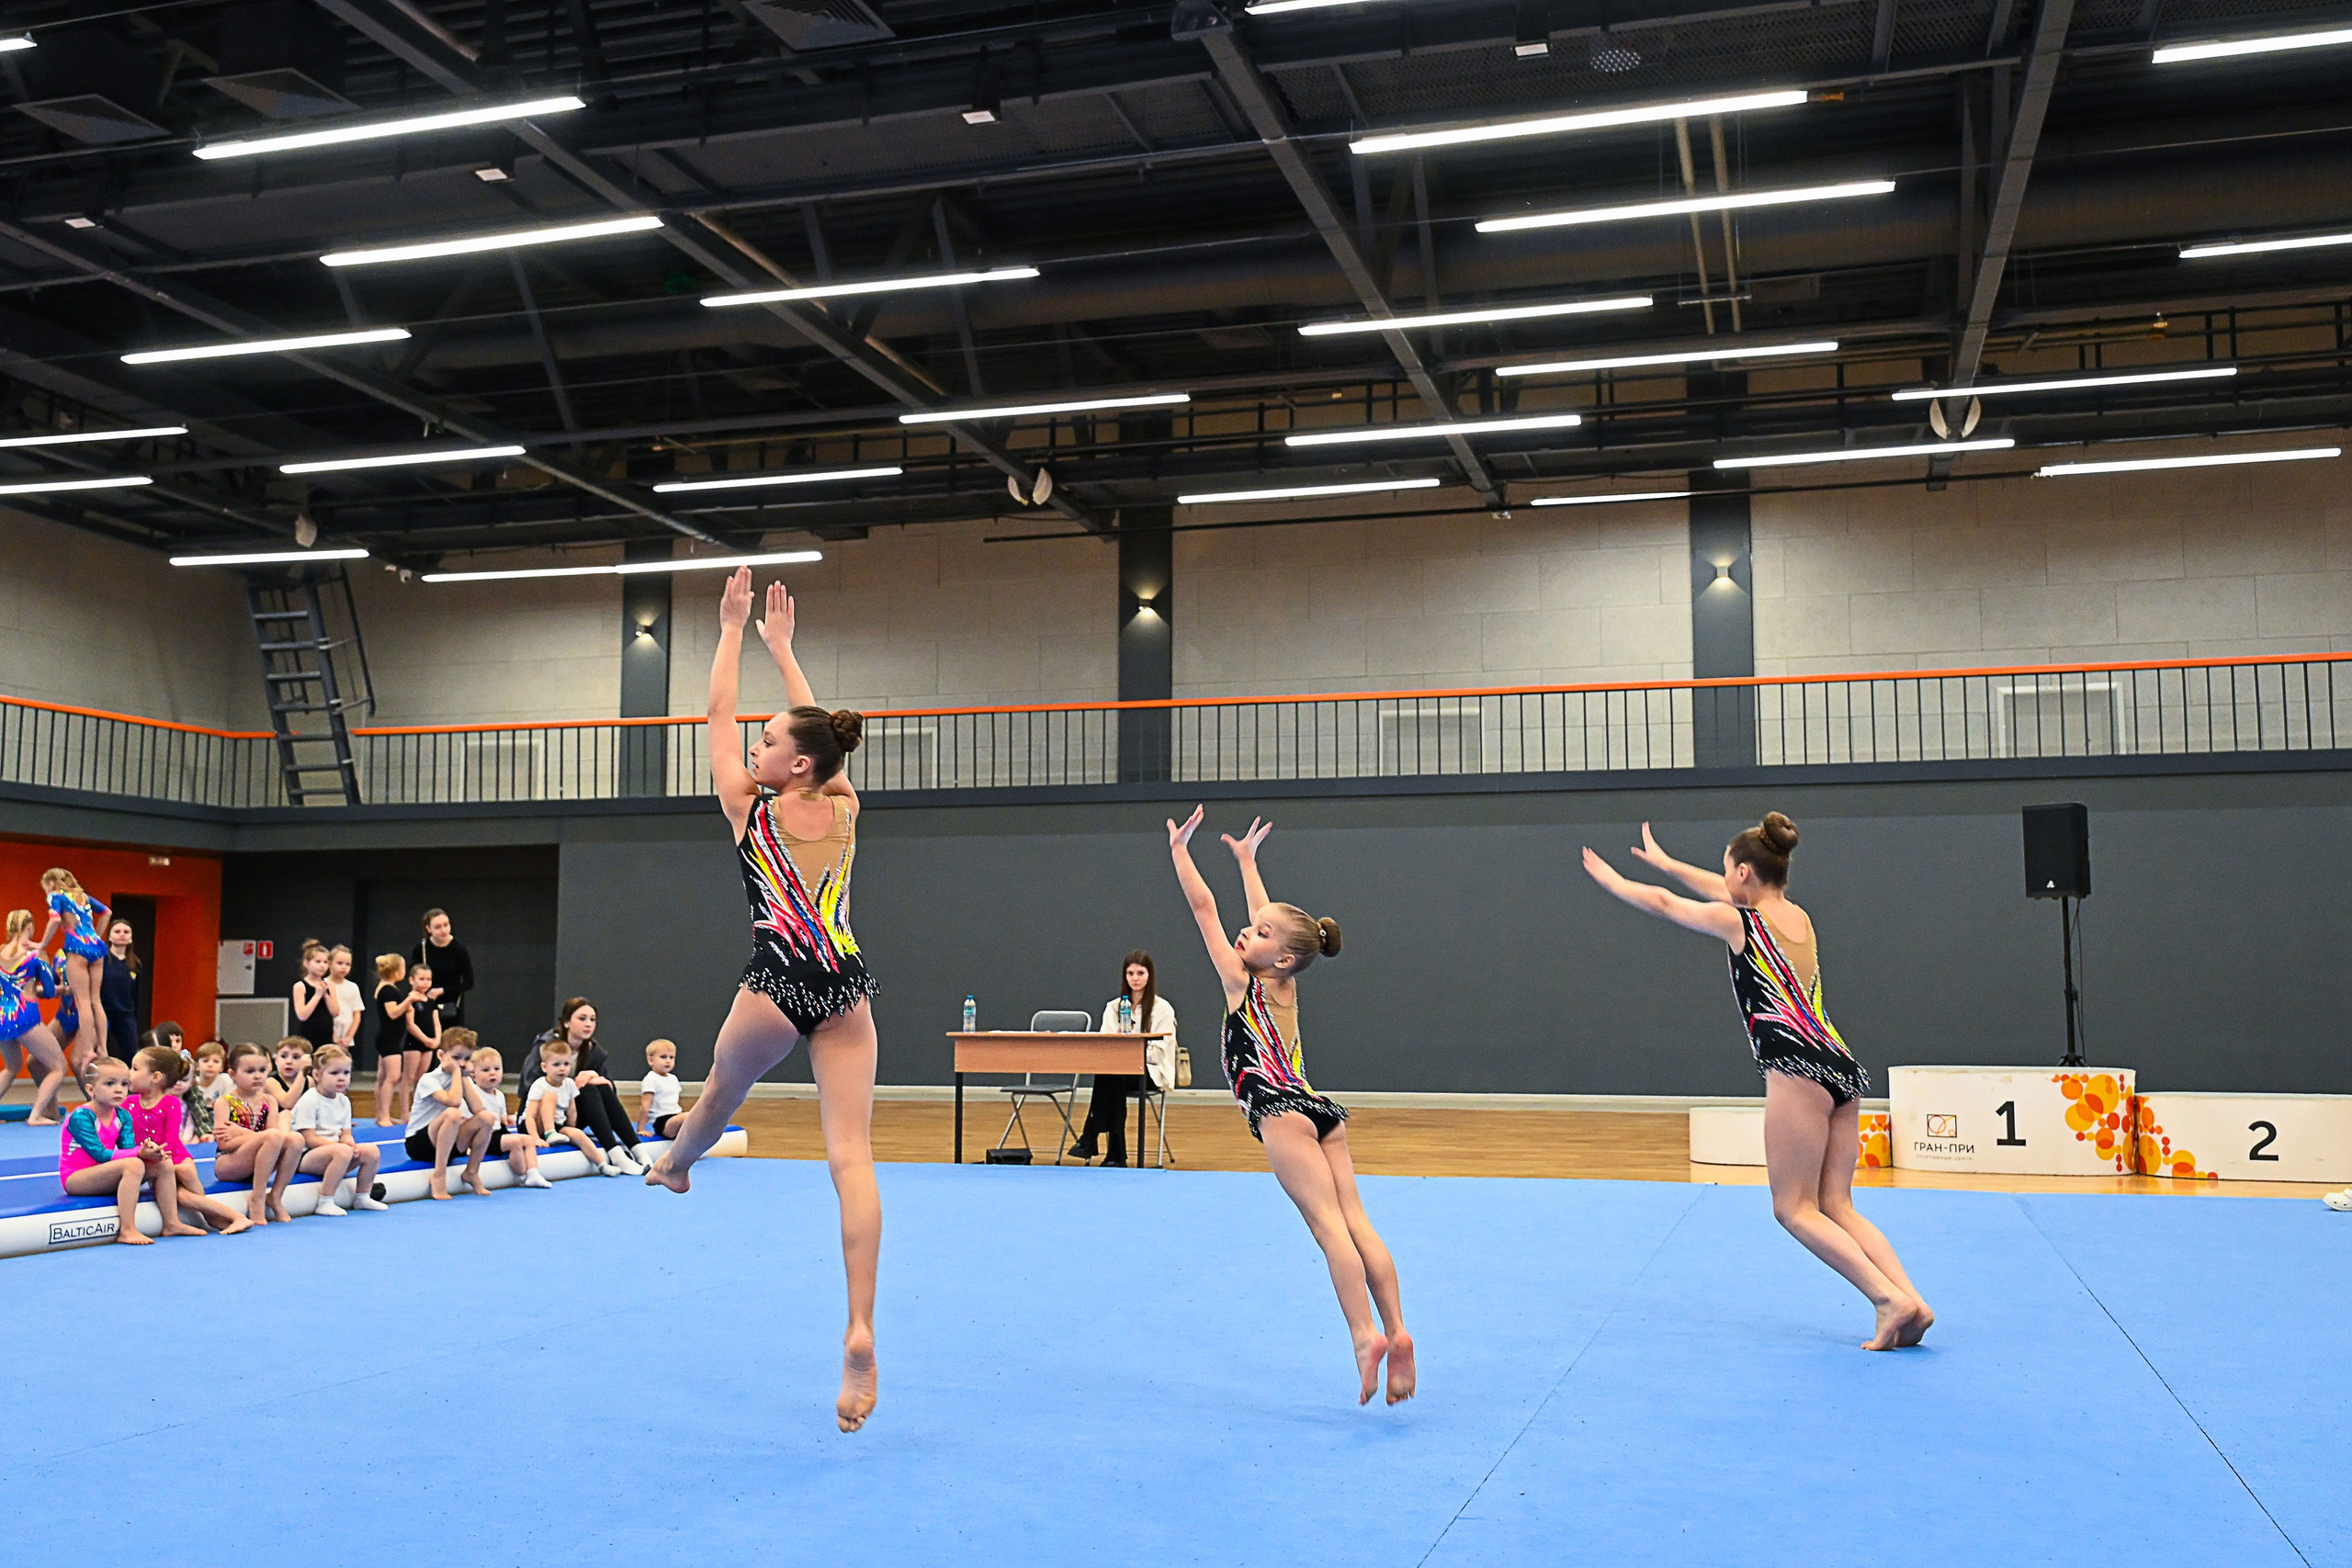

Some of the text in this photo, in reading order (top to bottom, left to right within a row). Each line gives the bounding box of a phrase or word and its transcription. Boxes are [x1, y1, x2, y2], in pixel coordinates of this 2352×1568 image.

[1996, 1100, 2027, 1146] 1
[2248, 1120, 2279, 1161] 2
[1914, 1141, 1975, 1154] ГРАН-ПРИ
